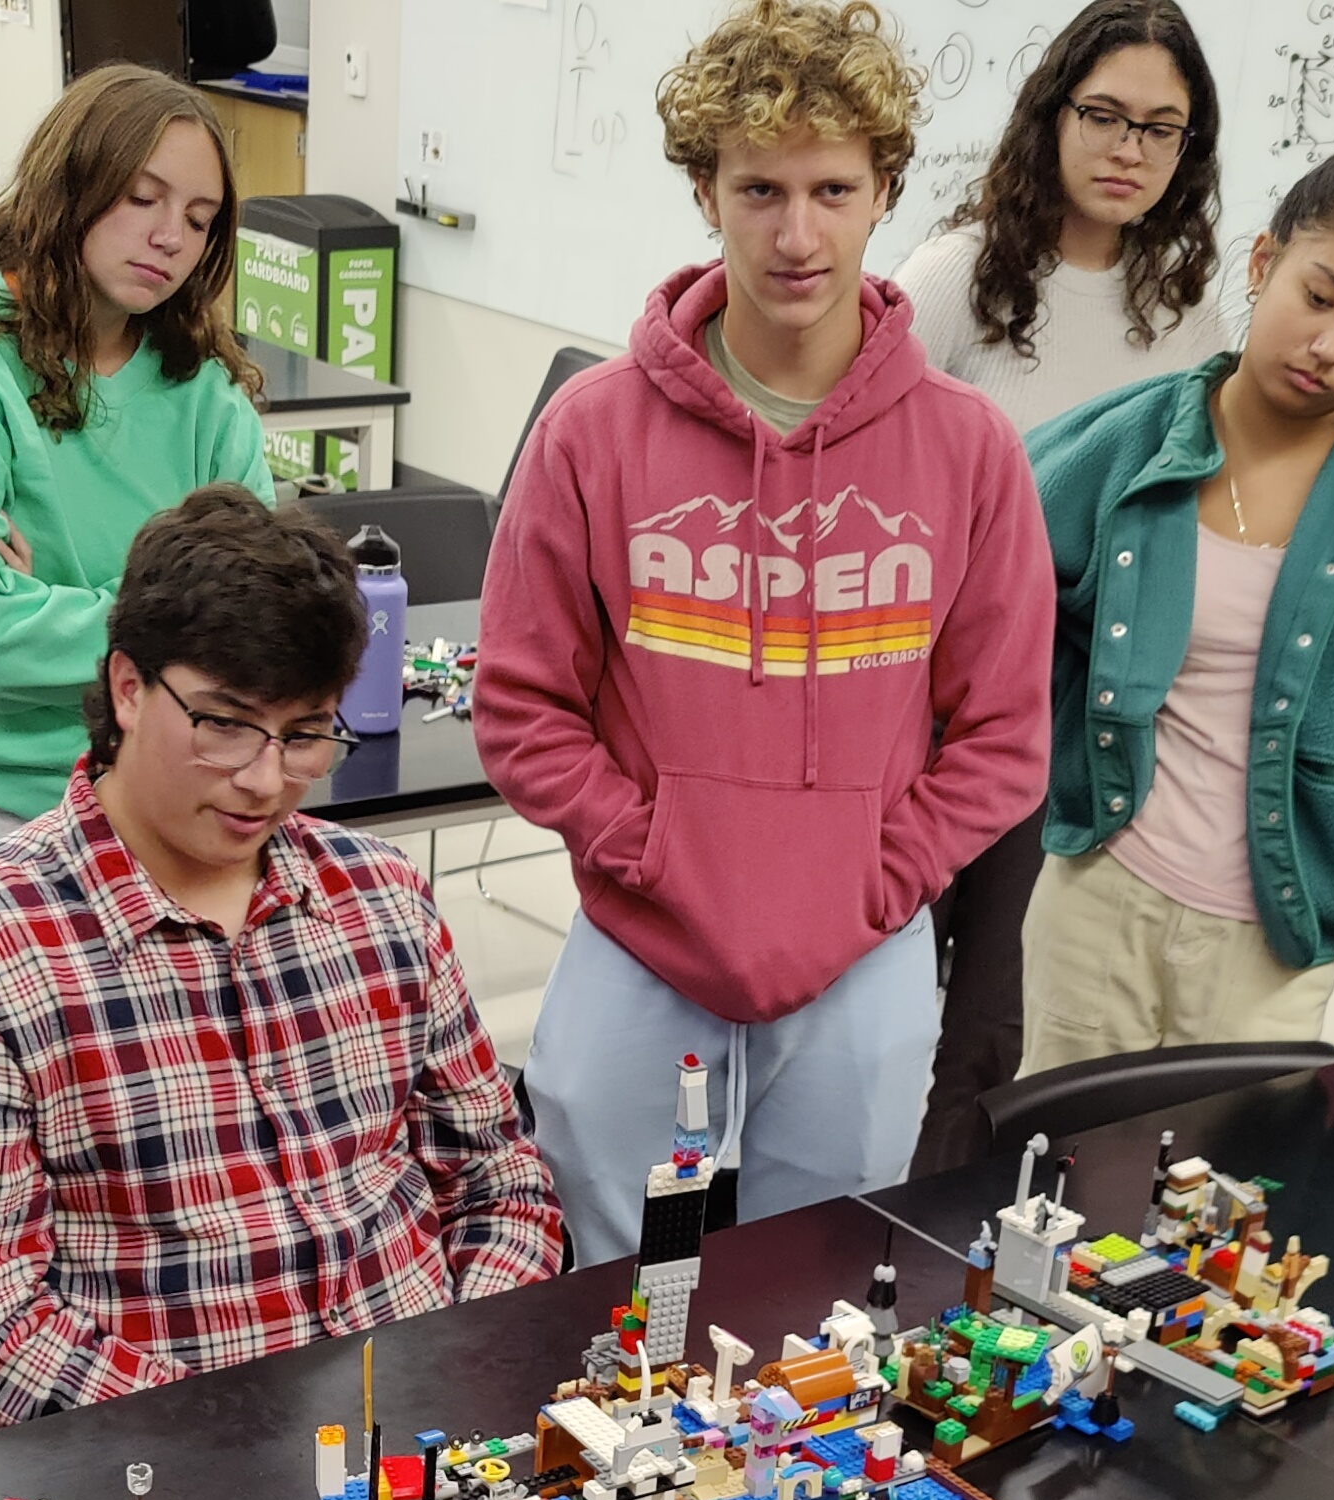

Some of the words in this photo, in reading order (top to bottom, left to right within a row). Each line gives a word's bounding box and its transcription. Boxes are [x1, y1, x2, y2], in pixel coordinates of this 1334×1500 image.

[255, 239, 299, 269] PAPER
[348, 258, 373, 269] PAPER
[244, 257, 310, 294] CARDBOARD
[264, 431, 311, 469] CYCLE
[629, 532, 932, 612] ASPEN
[853, 646, 930, 671] COLORADO
